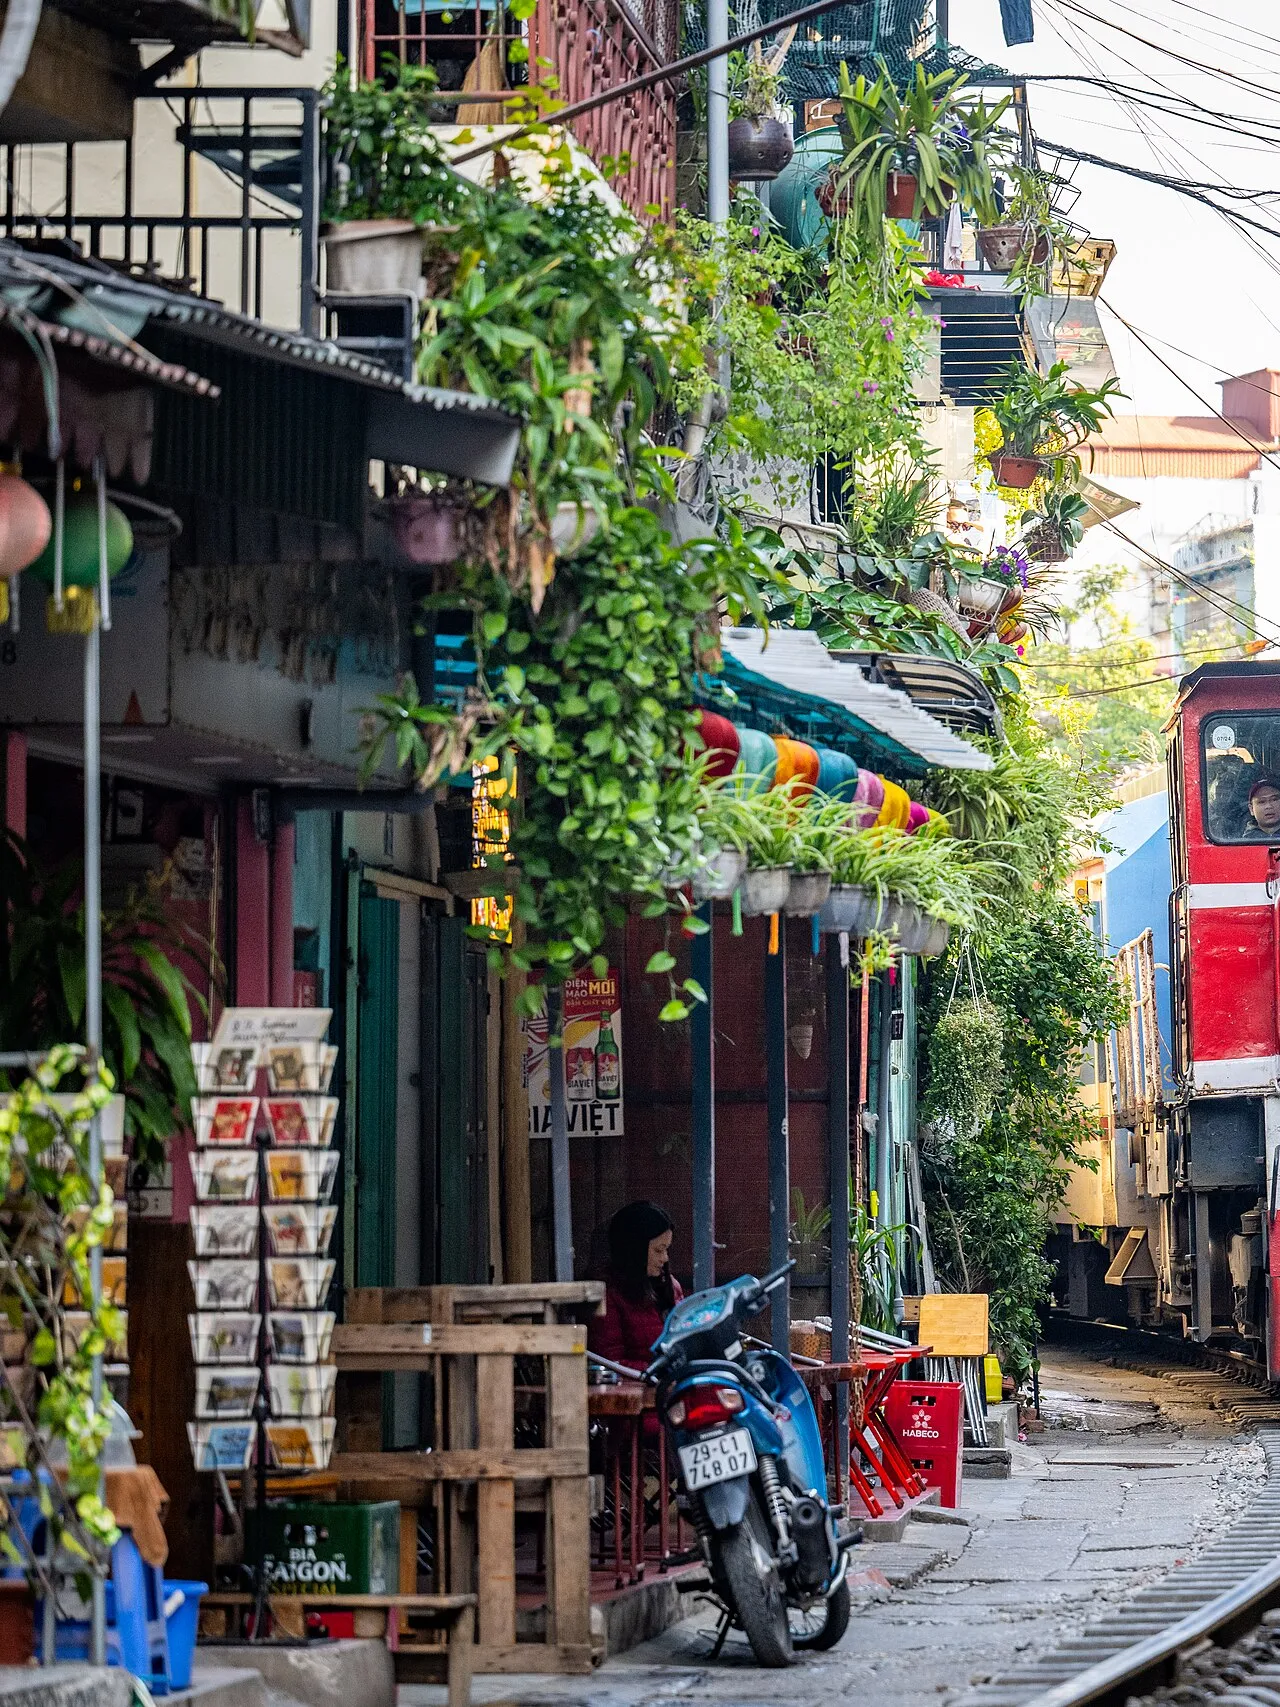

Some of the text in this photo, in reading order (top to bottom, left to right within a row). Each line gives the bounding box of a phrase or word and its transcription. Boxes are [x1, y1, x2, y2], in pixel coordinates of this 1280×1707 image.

[528, 1099, 620, 1136] IA VIỆT
[902, 1429, 939, 1438] HABECO
[690, 1436, 739, 1465] 29-C1
[289, 1548, 317, 1561] BIA
